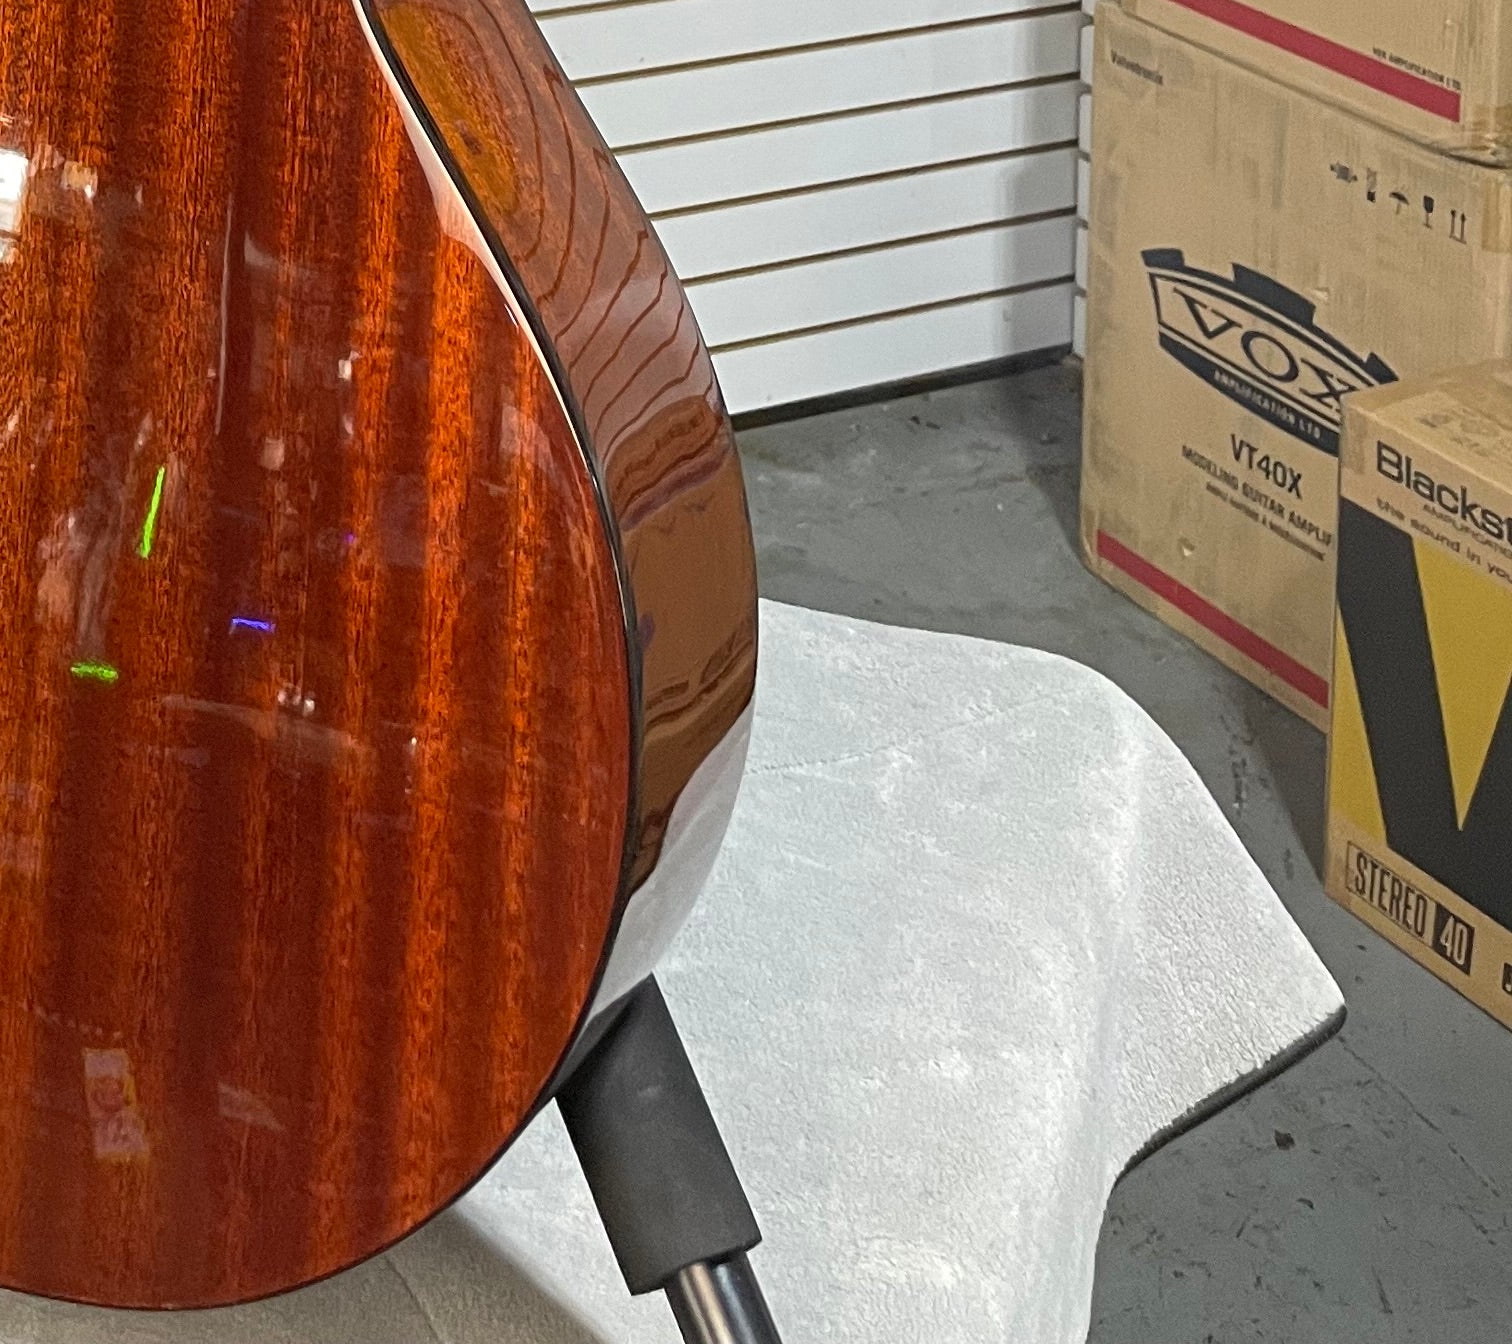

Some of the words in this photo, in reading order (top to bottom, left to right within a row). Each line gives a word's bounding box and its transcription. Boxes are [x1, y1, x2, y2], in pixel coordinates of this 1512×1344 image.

[1173, 287, 1359, 412] VOX
[1213, 369, 1297, 424] AMPLIFICATION
[1181, 444, 1240, 491] MODELING
[1242, 481, 1286, 519] GUITAR
[1230, 433, 1303, 500] VT40X
[1376, 496, 1405, 522] the
[1410, 519, 1461, 554] sound
[1466, 546, 1481, 566] in
[1354, 852, 1428, 939] STEREO
[1439, 914, 1469, 966] 40
